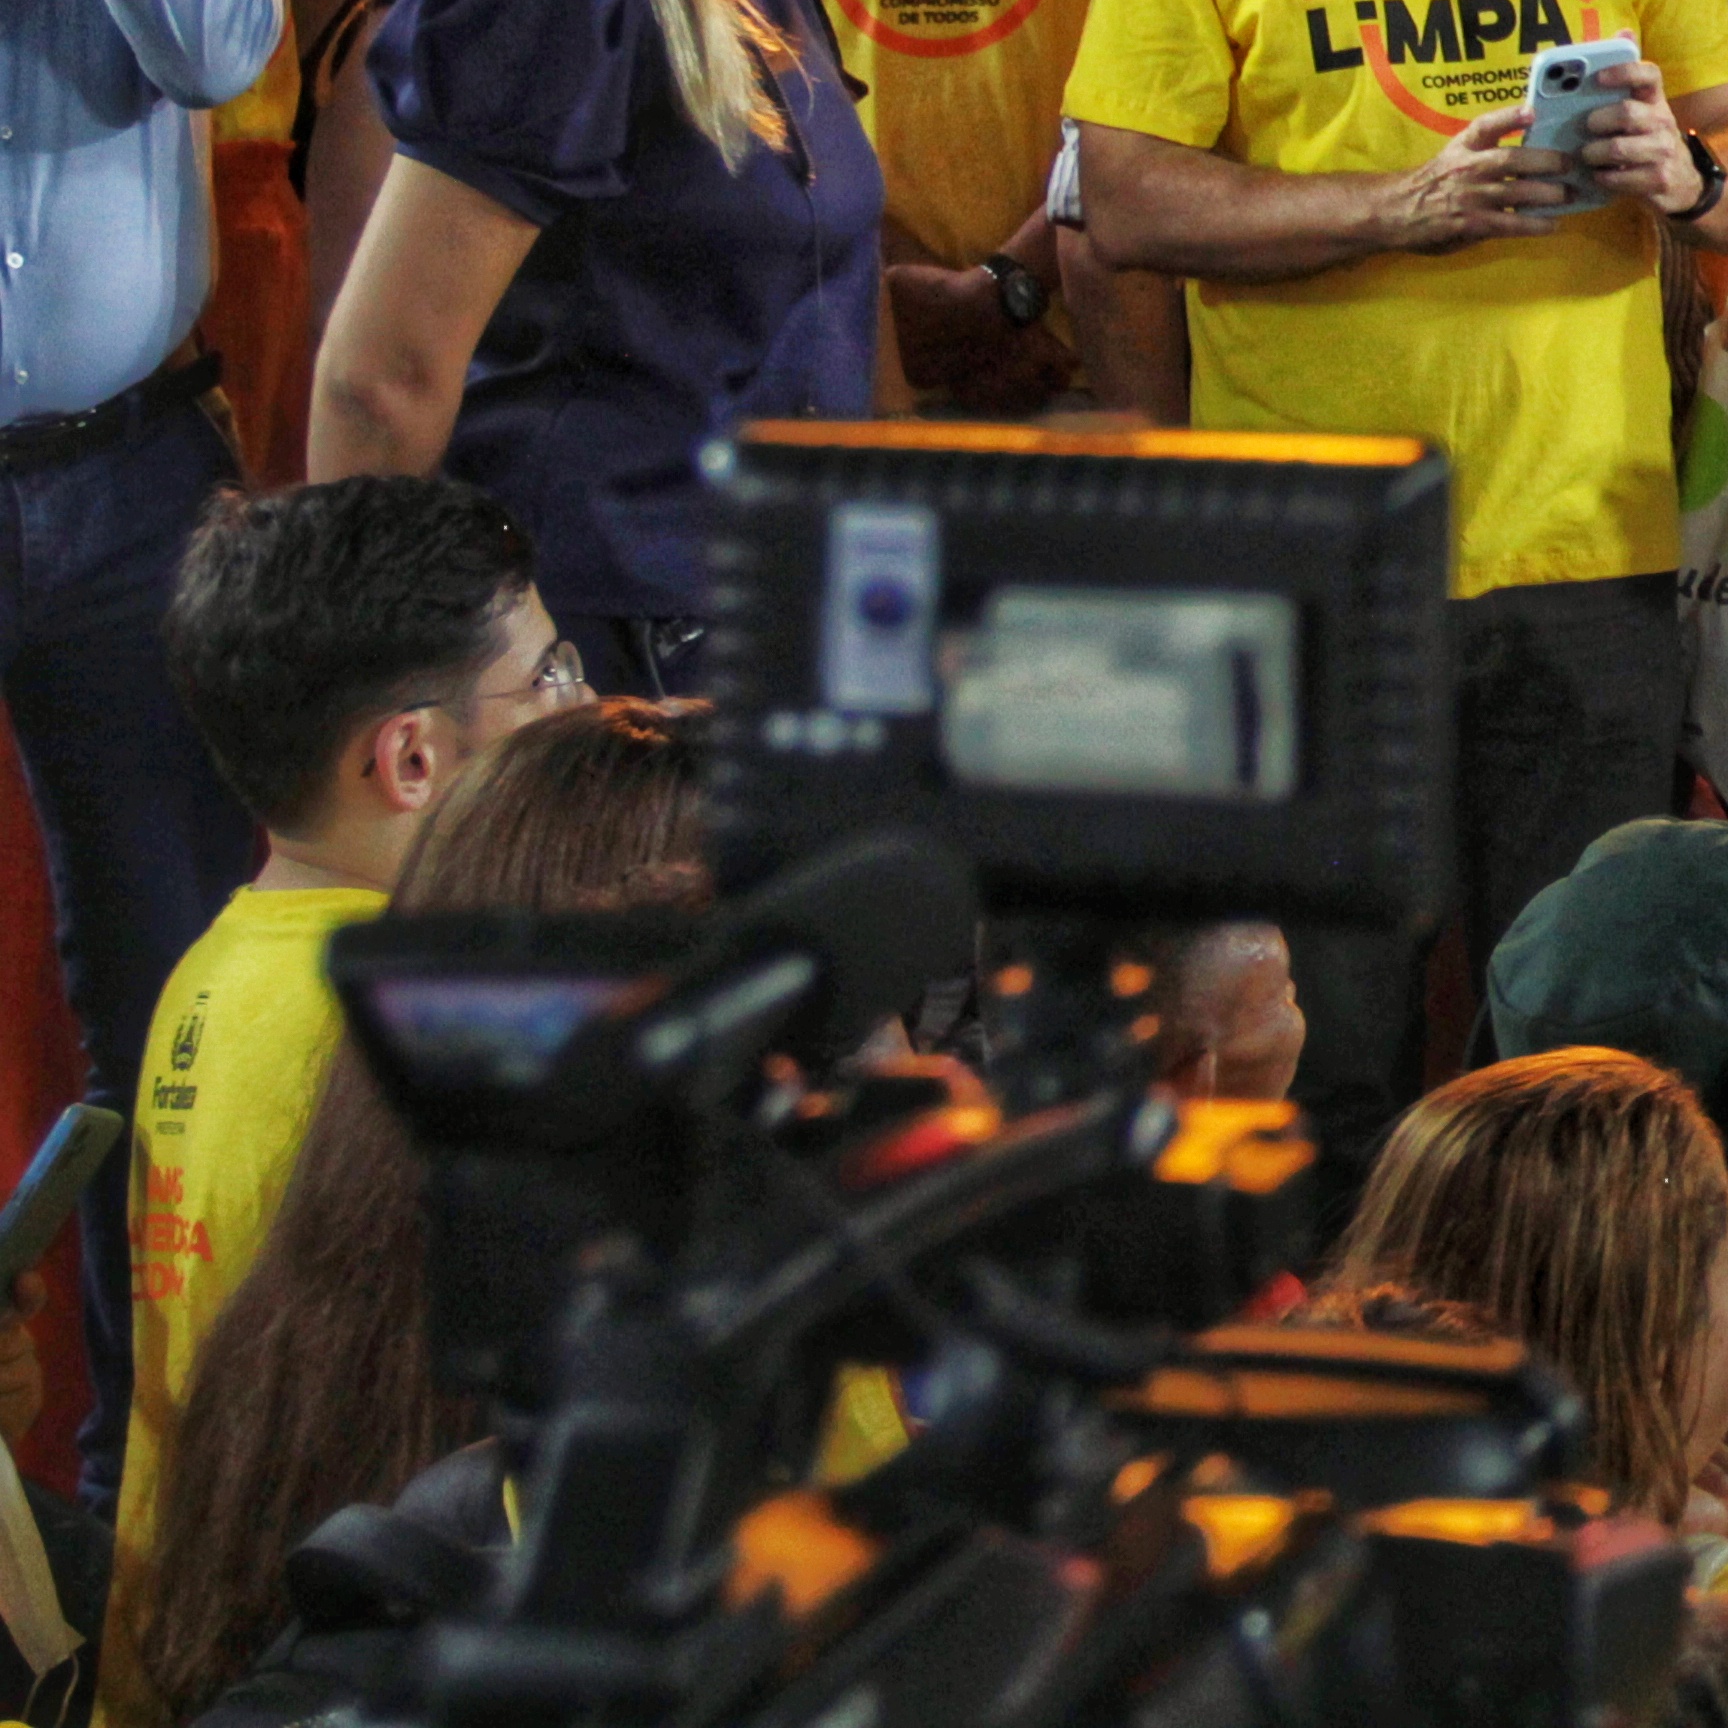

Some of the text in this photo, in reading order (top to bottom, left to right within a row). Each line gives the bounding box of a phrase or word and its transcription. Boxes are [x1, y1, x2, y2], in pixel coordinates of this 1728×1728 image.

[898, 10, 979, 26] DE TODOS
[1445, 90, 1469, 107] DE
